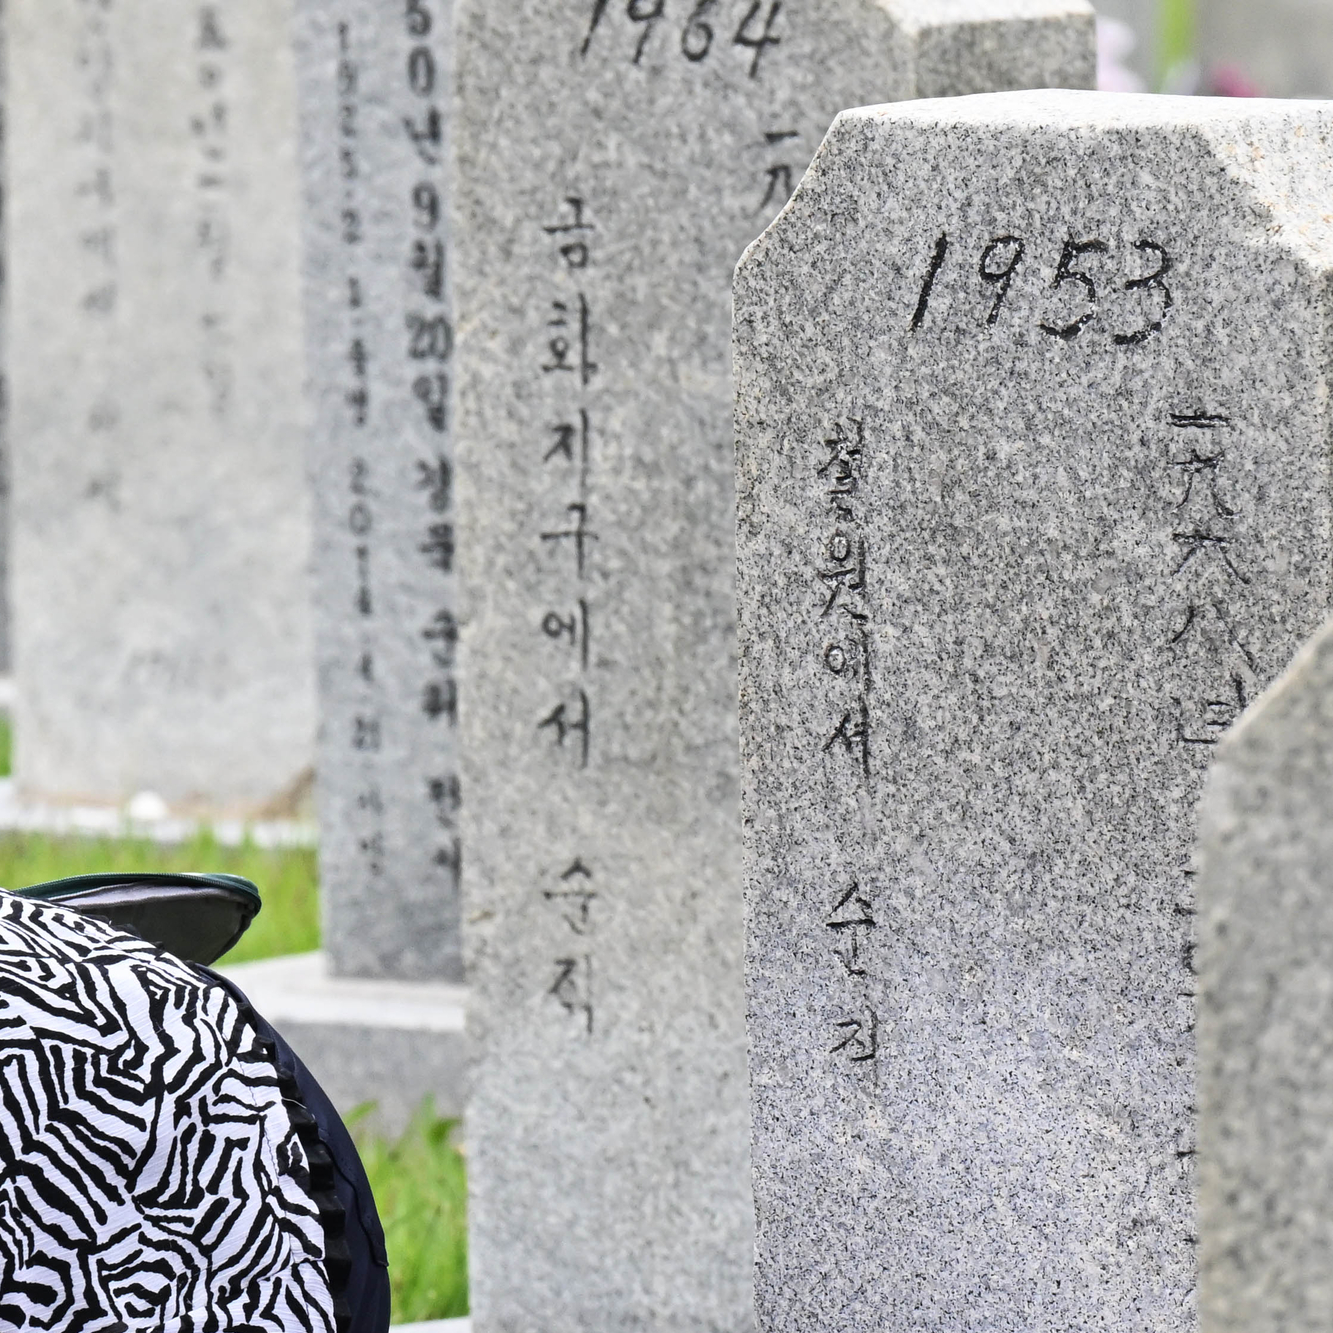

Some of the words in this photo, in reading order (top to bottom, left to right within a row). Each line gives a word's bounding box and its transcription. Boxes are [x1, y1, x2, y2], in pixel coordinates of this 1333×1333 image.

[579, 0, 789, 80] 1964
[908, 230, 1174, 348] 1953
[539, 196, 601, 772] 금화지구에서
[540, 856, 599, 1036] 순직
